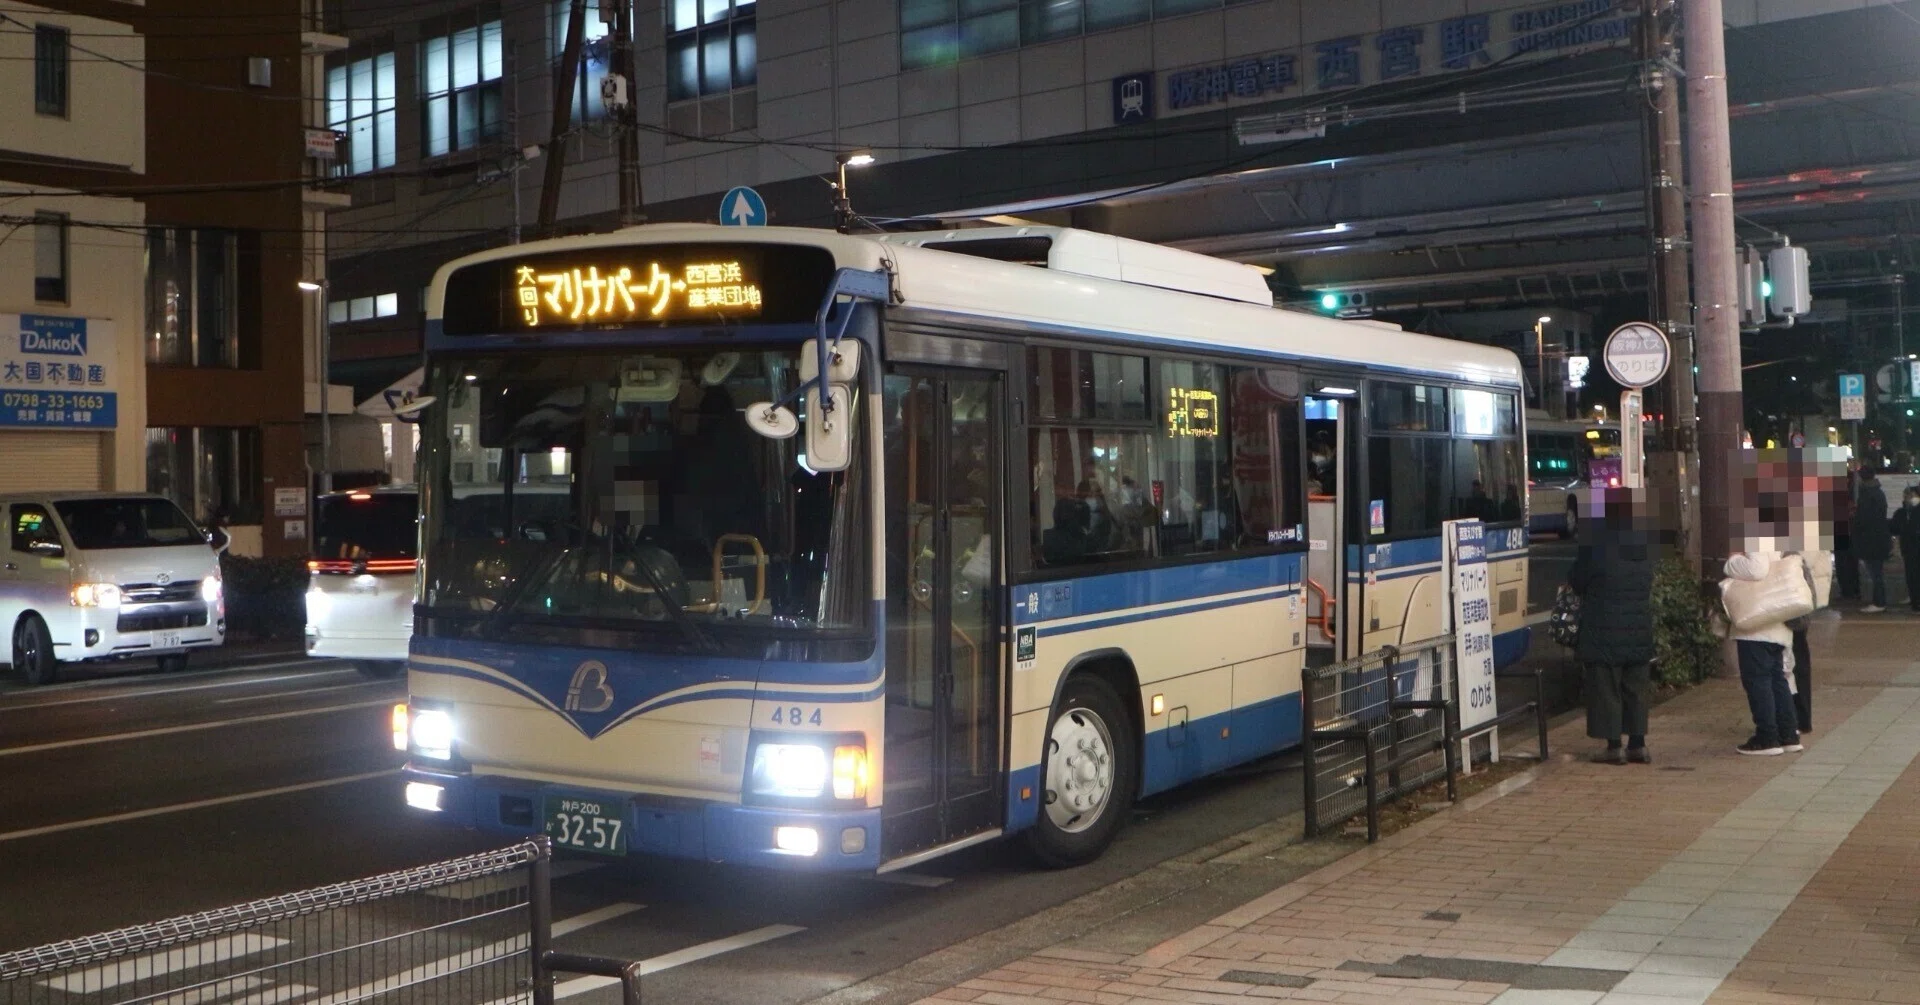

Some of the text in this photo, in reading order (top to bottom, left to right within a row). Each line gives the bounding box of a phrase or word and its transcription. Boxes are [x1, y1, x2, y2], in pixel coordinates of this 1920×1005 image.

[1512, 0, 1612, 31] HANSHIN
[1168, 54, 1296, 109] 阪神電車
[685, 261, 742, 285] 西宮浜
[538, 263, 671, 319] マリナパーク
[687, 284, 762, 309] 産業団地
[1612, 338, 1661, 352] 阪神バス
[3, 361, 106, 386] 大国不動産
[1616, 358, 1659, 373] のりば
[4, 393, 104, 409] 0798-33-1663
[1506, 527, 1524, 550] 484
[1016, 592, 1039, 615] 一般
[1470, 681, 1493, 708] のりば
[771, 706, 823, 726] 484
[556, 813, 622, 851] 32-57
